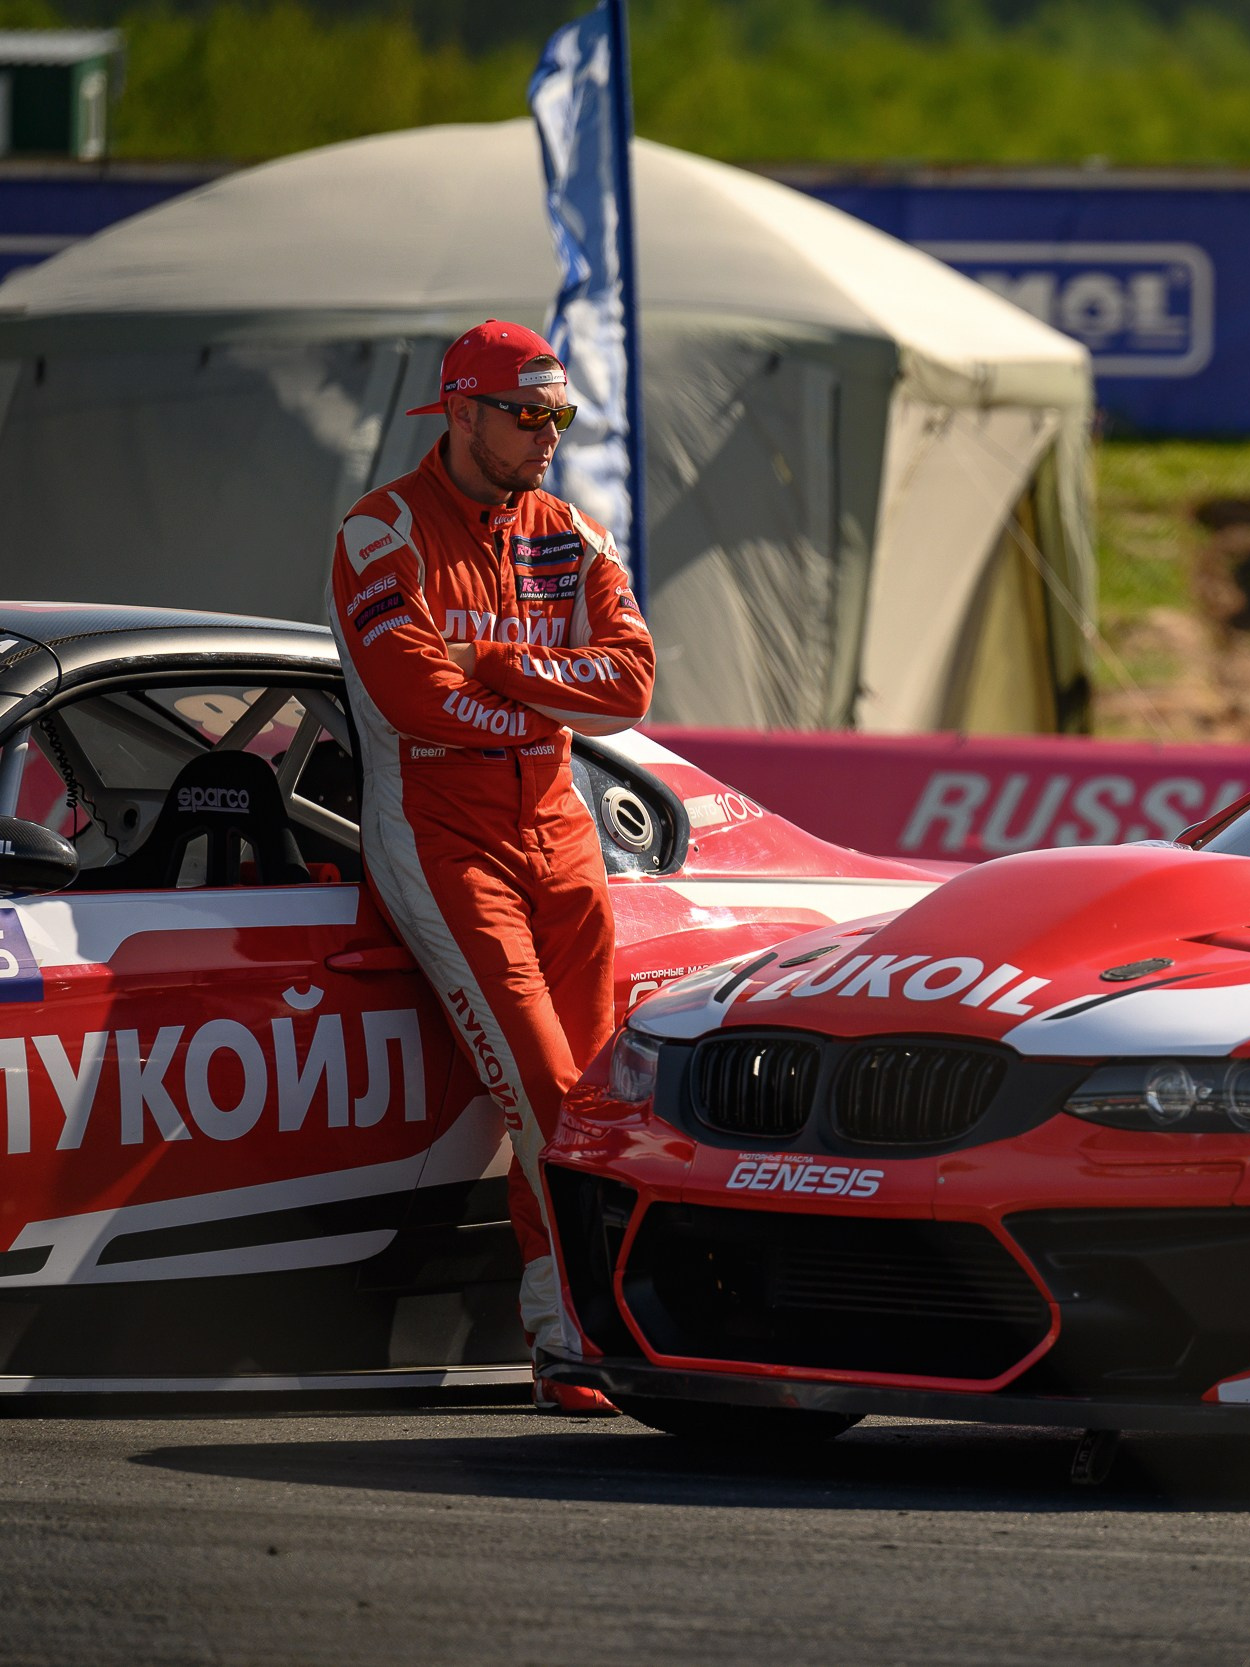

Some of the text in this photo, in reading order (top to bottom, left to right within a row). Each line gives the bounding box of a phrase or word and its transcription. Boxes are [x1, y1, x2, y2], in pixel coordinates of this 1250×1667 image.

[978, 272, 1187, 352] MOL
[456, 377, 477, 390] 100
[516, 542, 580, 557] RDS EUROPE
[347, 575, 398, 616] GENESIS
[522, 574, 577, 592] RDS GP
[521, 654, 621, 683] LUKOIL
[442, 689, 528, 737] LUKOIL
[411, 746, 446, 759] freem
[177, 786, 250, 812] sparco
[689, 792, 764, 823] ЭКТО 100
[630, 966, 685, 982] МОТОРНЫЕ
[746, 953, 1052, 1016] LUKOIL
[447, 987, 524, 1131] ЛУКОЙЛ
[738, 1153, 814, 1164] МОТОРНЫЕ МАСЛА
[726, 1161, 885, 1198] GENESIS
